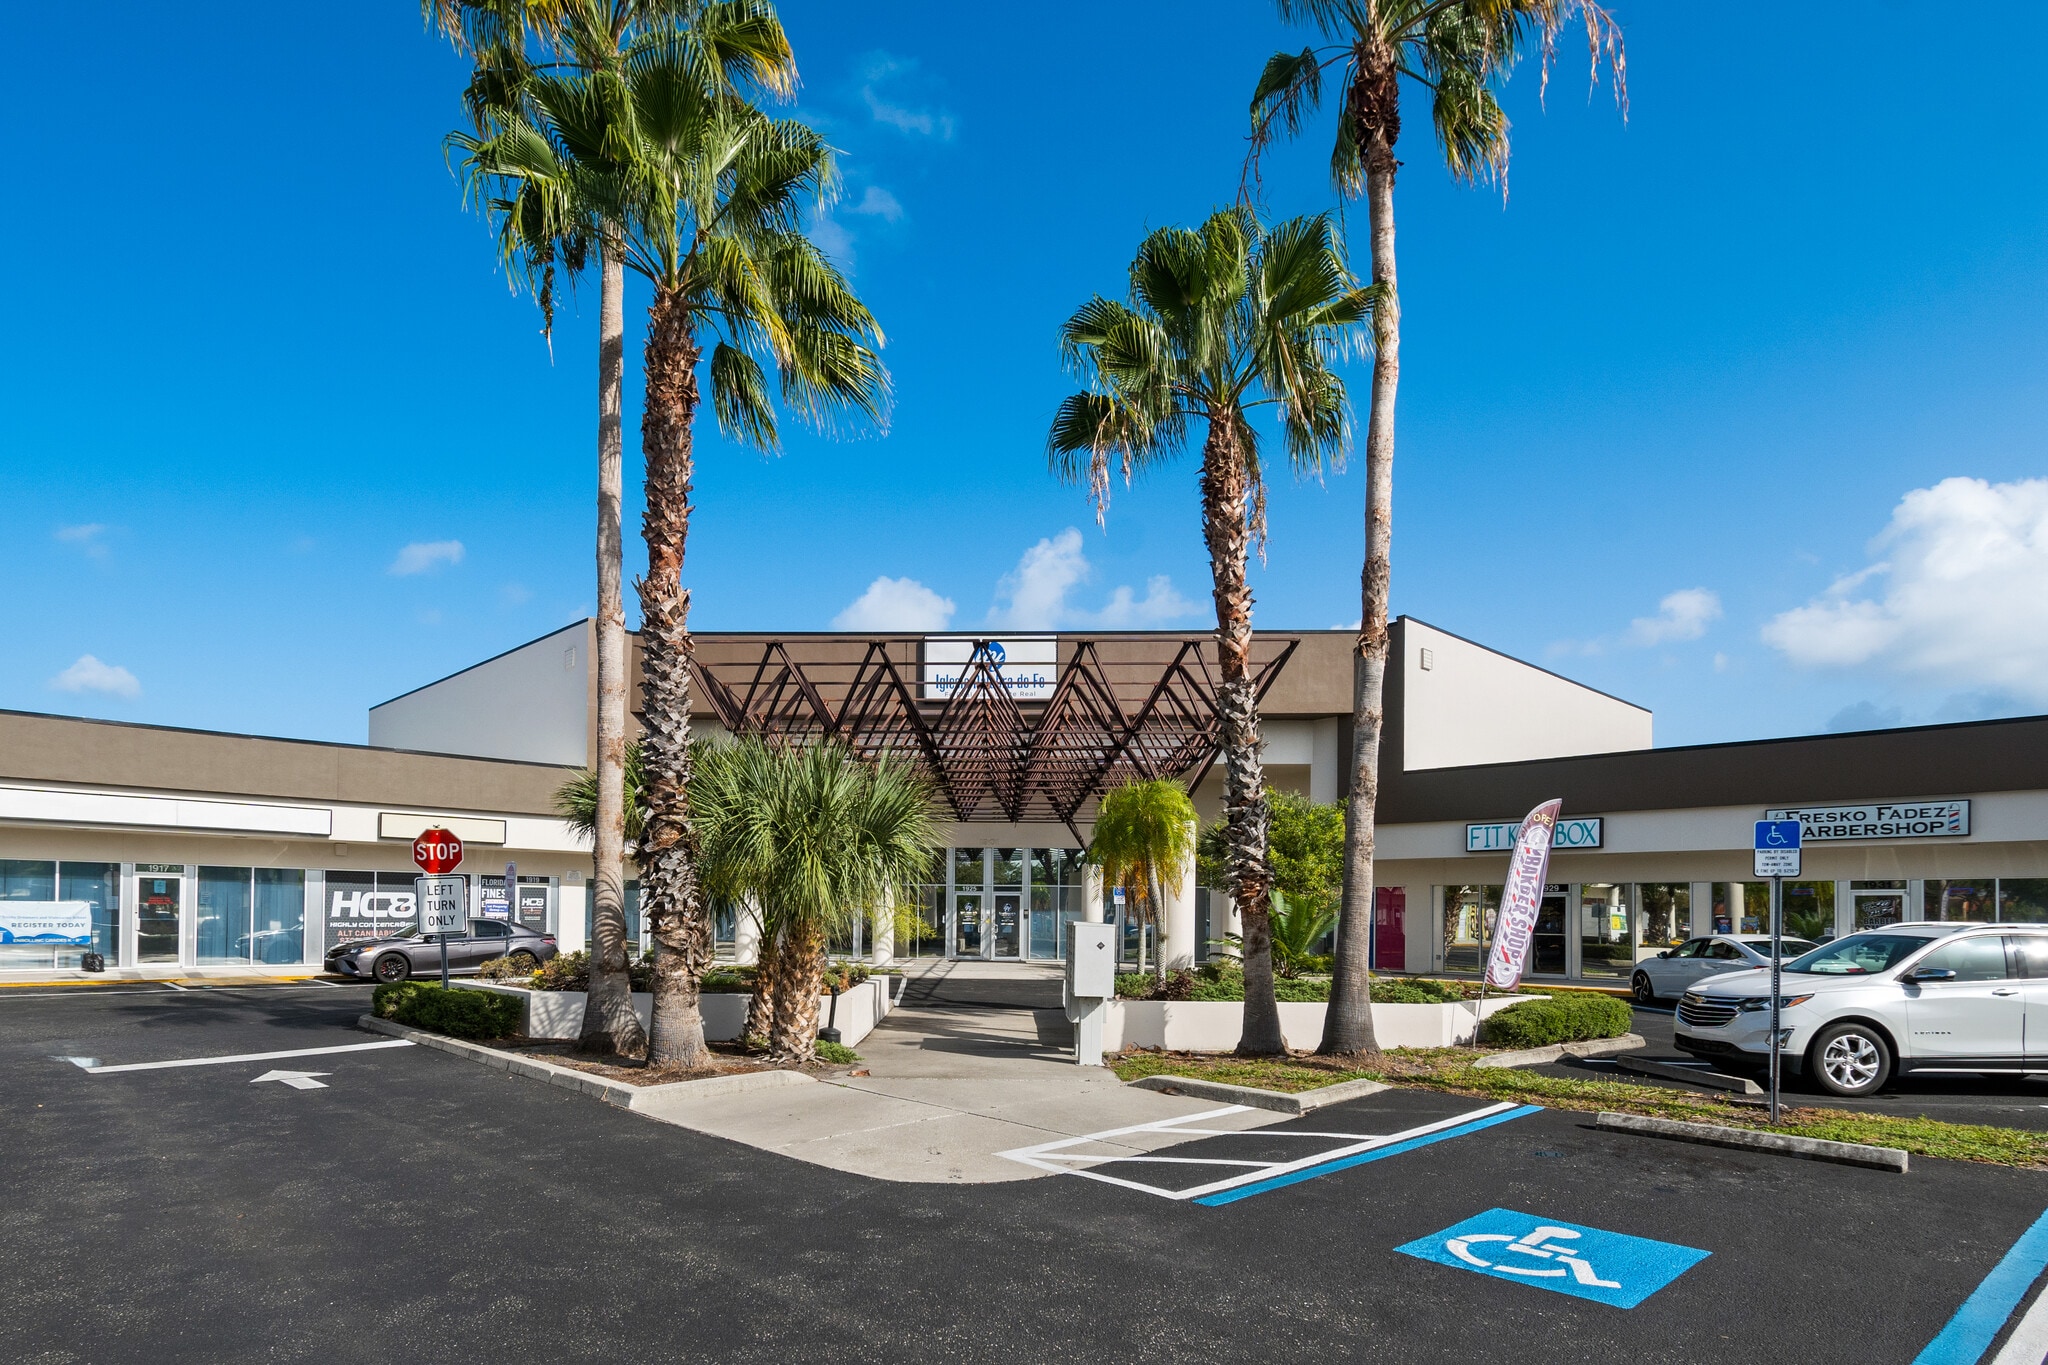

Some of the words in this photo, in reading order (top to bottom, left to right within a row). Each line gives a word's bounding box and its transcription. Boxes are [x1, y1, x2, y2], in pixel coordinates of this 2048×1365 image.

[1802, 821, 1945, 838] ARBERSHOP
[1470, 825, 1503, 849] FIT
[416, 843, 460, 861] STOP
[427, 885, 453, 896] LEFT
[481, 888, 506, 899] FINES
[1542, 884, 1559, 892] 929
[427, 900, 455, 911] TURN
[428, 915, 455, 926] ONLY
[1507, 916, 1528, 959] SHOP
